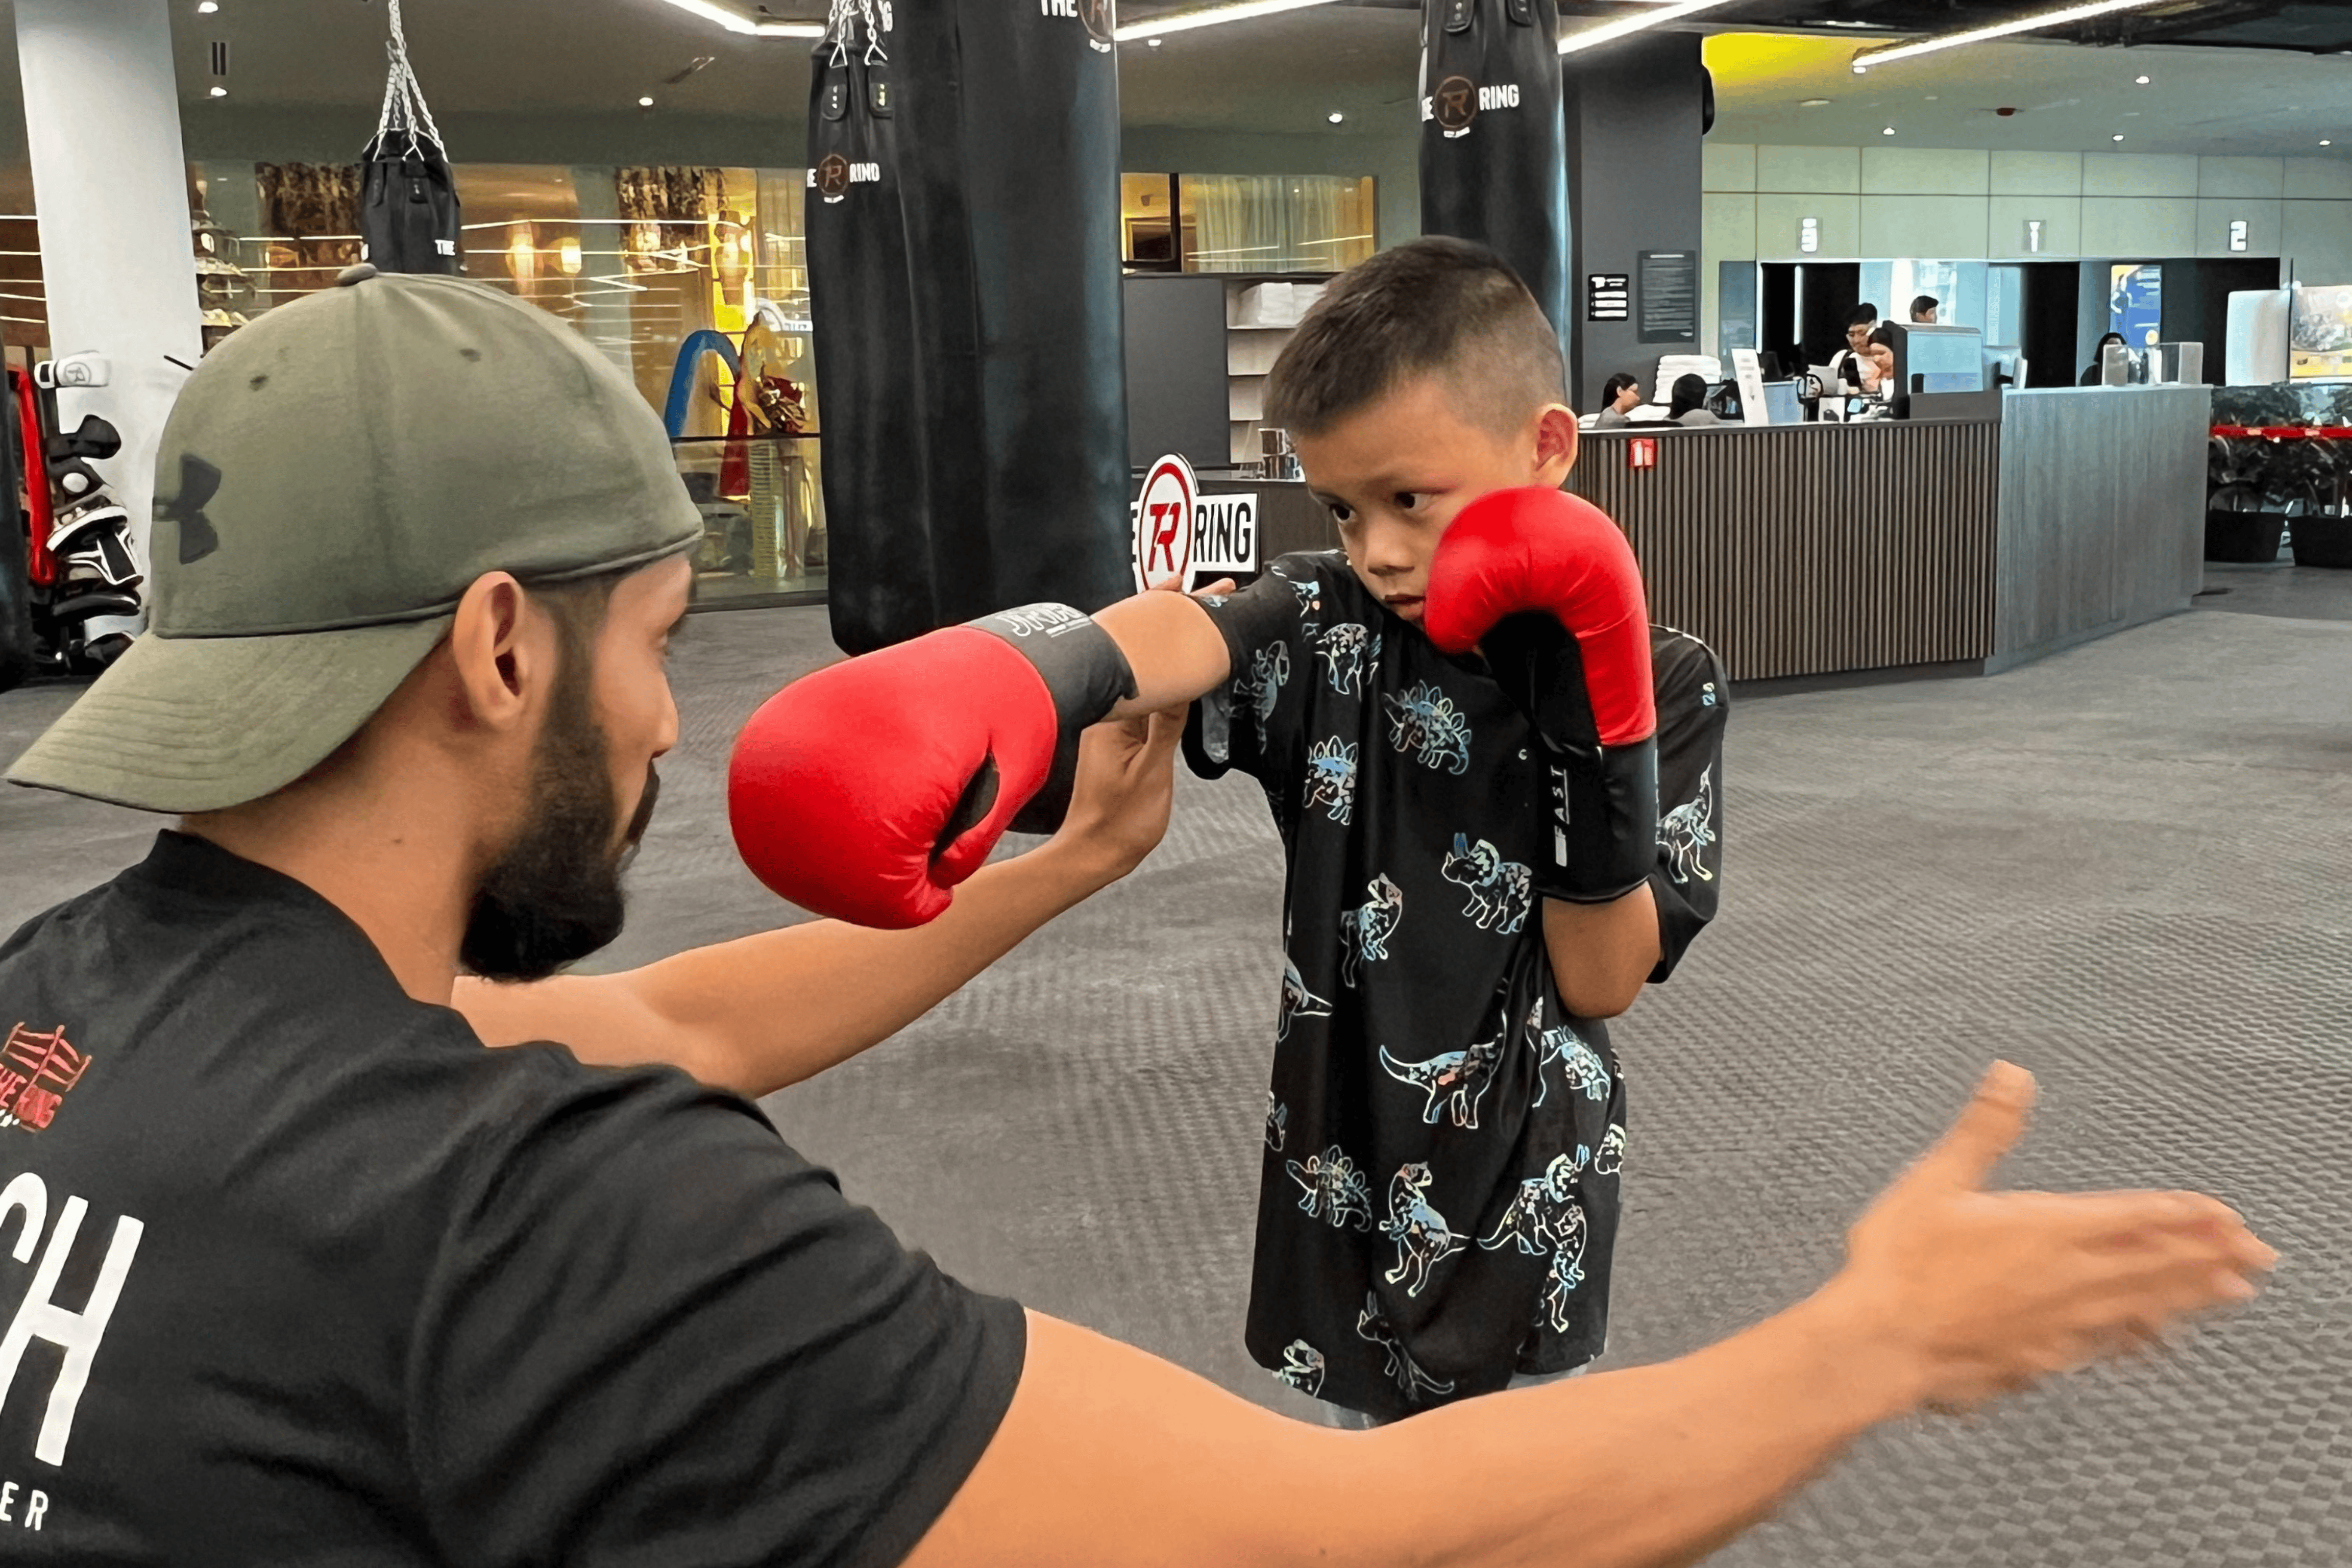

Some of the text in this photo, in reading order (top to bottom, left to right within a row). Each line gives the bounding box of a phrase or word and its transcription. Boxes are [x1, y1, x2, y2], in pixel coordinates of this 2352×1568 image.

[1479, 84, 1520, 111] RING
[2230, 220, 2247, 251] 2
[1193, 502, 1251, 563] RING
